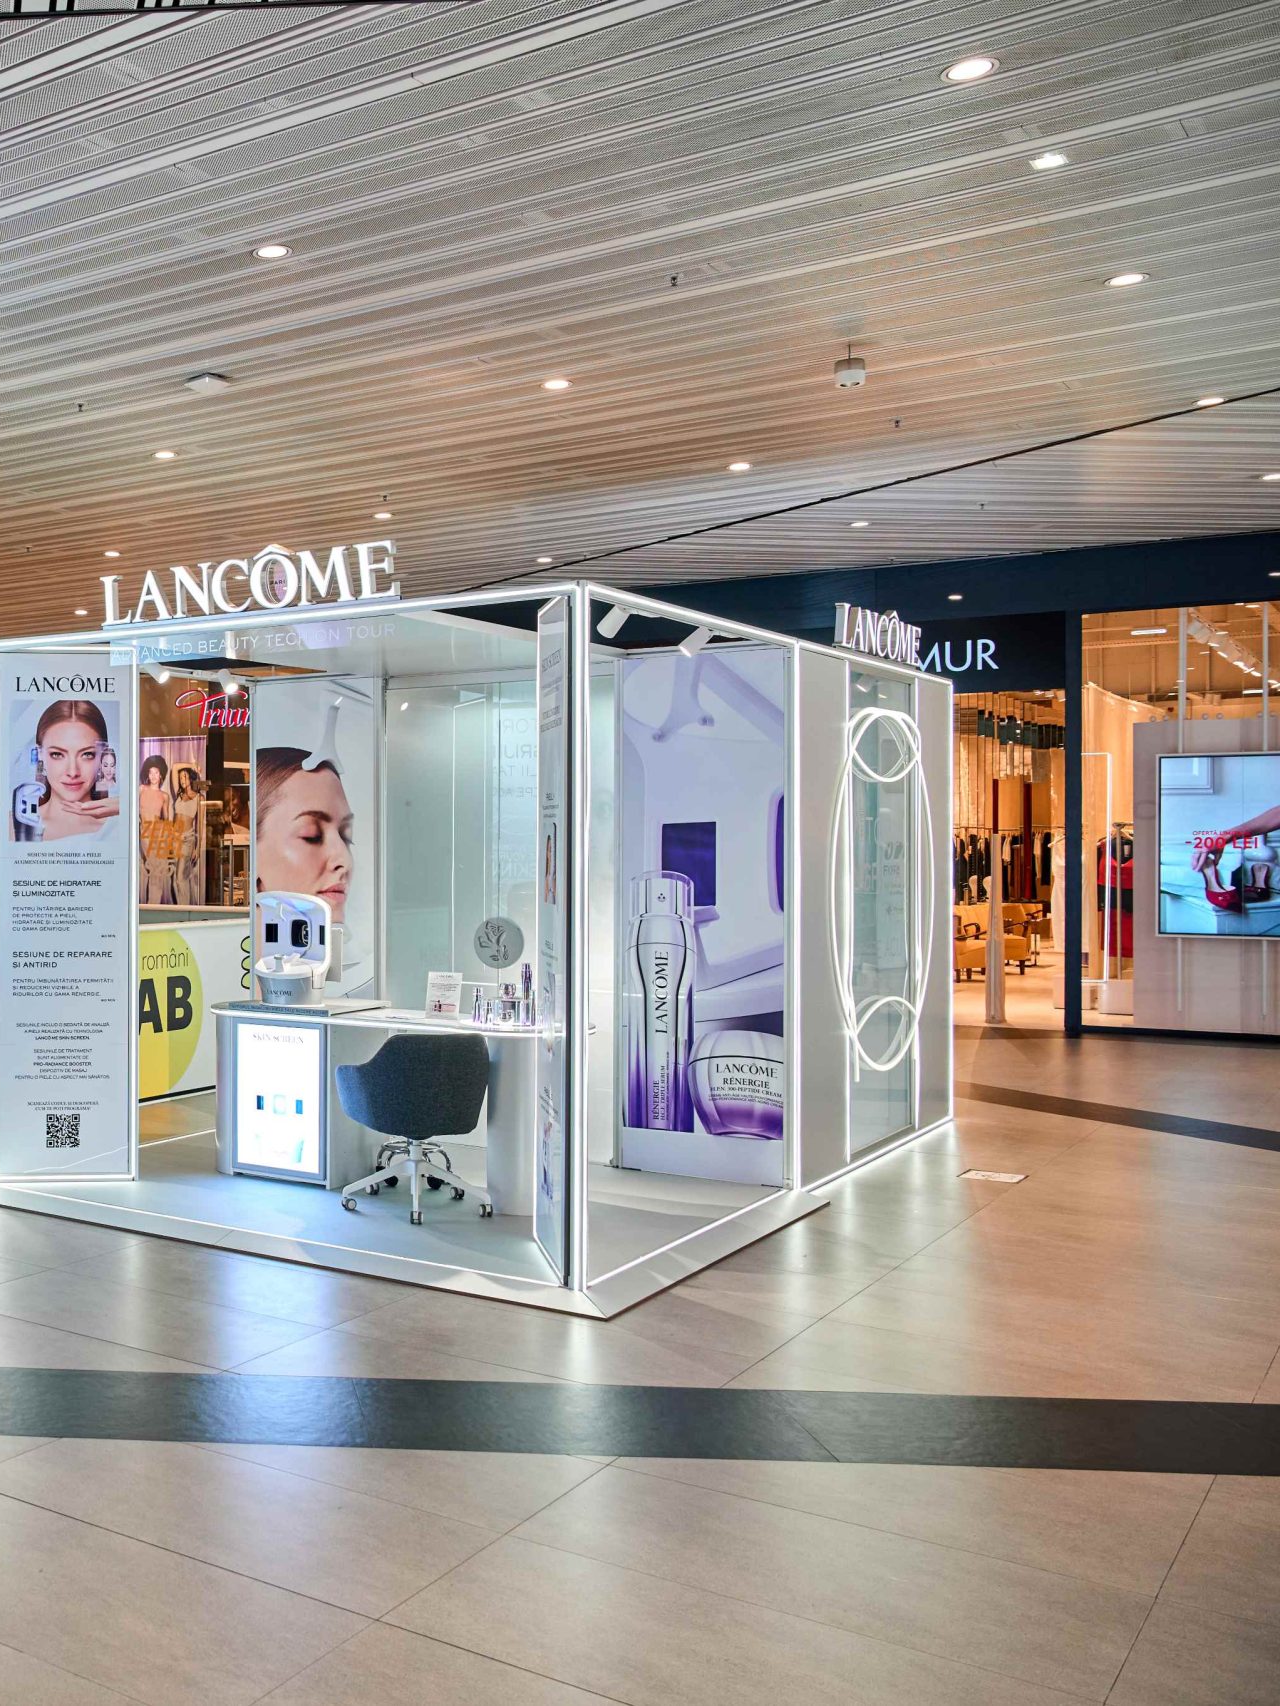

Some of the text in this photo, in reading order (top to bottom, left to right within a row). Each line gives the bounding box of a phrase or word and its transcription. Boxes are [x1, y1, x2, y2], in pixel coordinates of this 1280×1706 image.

[99, 540, 401, 625] LANCÔME
[198, 635, 260, 656] BEAUTY
[346, 623, 396, 639] TOUR
[835, 603, 922, 666] LANCÔME
[15, 674, 116, 694] LANCÔME
[1185, 836, 1258, 849] -200 LEI
[142, 947, 190, 971] români
[653, 951, 669, 1035] LANCÔME
[716, 1062, 778, 1079] LANCÔME
[723, 1076, 770, 1090] RÉNERGIE
[651, 1080, 660, 1120] RÉNERGIE
